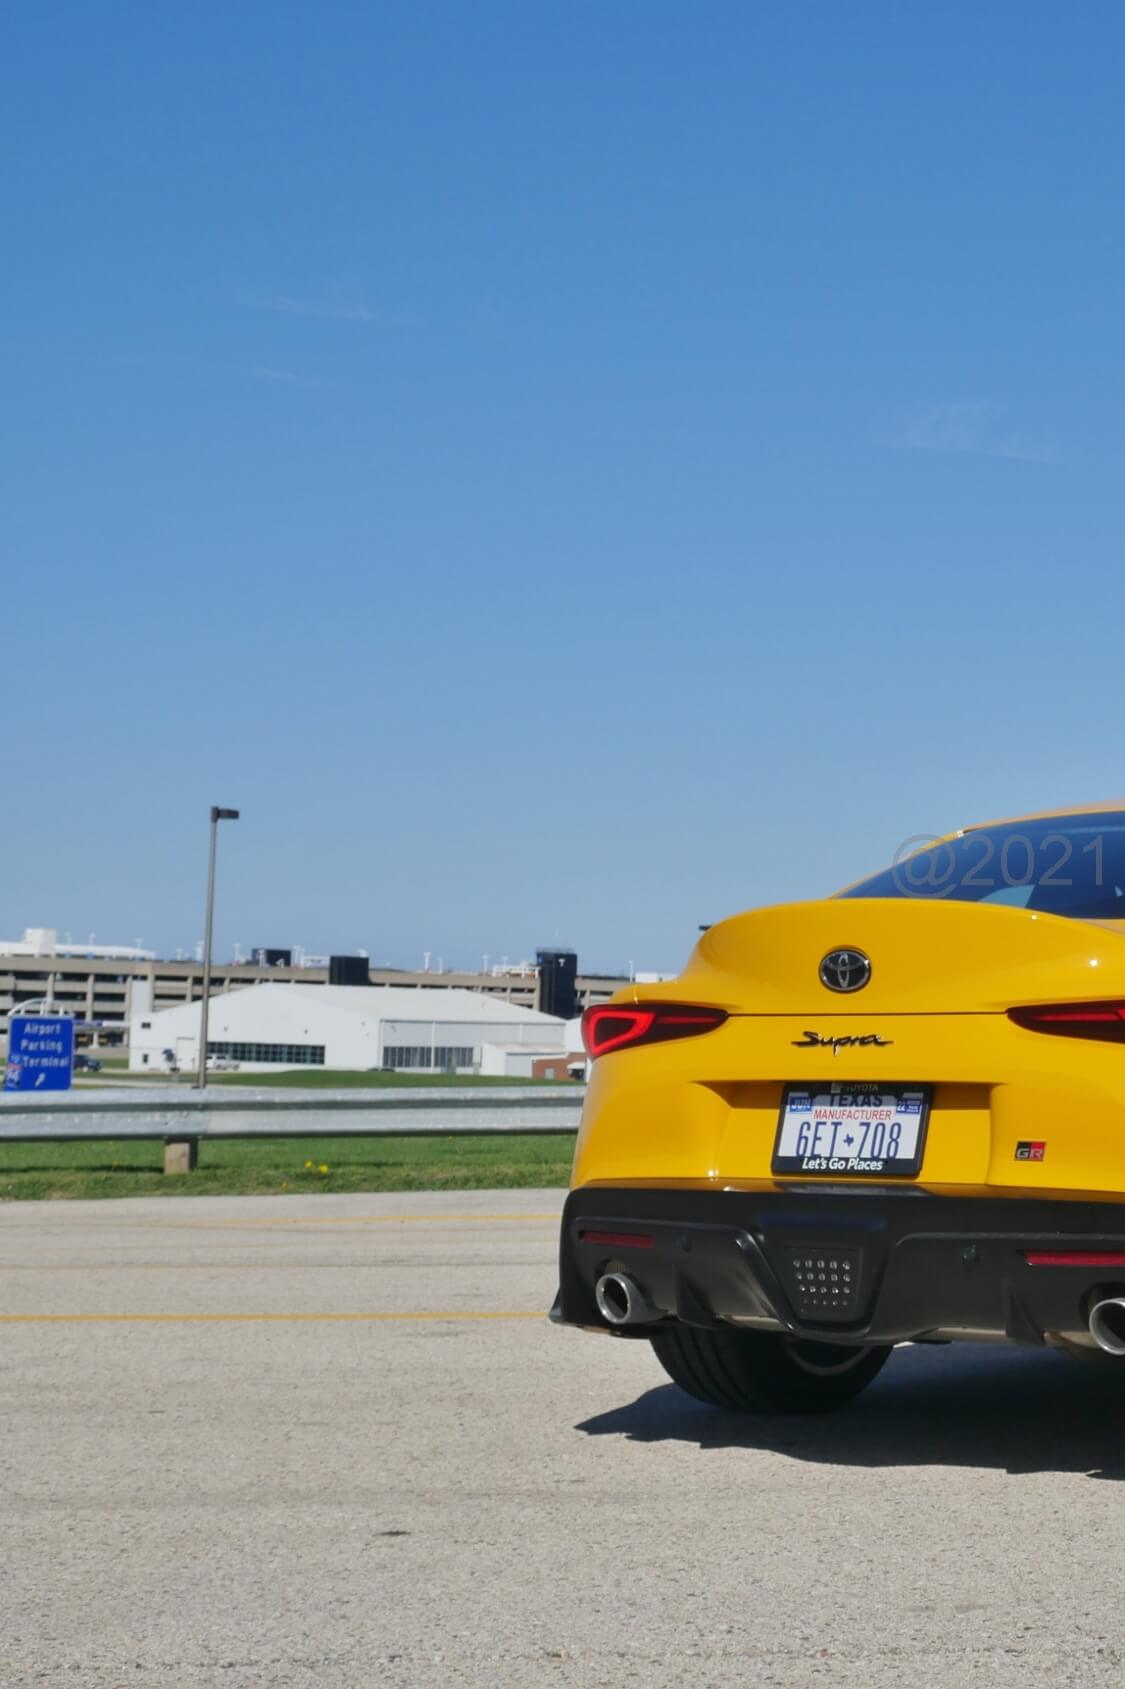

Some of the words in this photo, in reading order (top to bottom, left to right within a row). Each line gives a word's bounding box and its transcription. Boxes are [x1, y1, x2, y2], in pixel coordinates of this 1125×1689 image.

[24, 1022, 61, 1036] Airport
[20, 1038, 63, 1054] Parking
[791, 1031, 894, 1056] Supra
[22, 1055, 70, 1068] Terminal
[830, 1094, 883, 1107] TEXAS
[813, 1109, 892, 1120] MANUFACTURER
[857, 1122, 902, 1159] 708
[1016, 1148, 1043, 1159] GR
[802, 1158, 827, 1169] Let's
[829, 1158, 846, 1169] Go
[847, 1158, 884, 1171] Places
